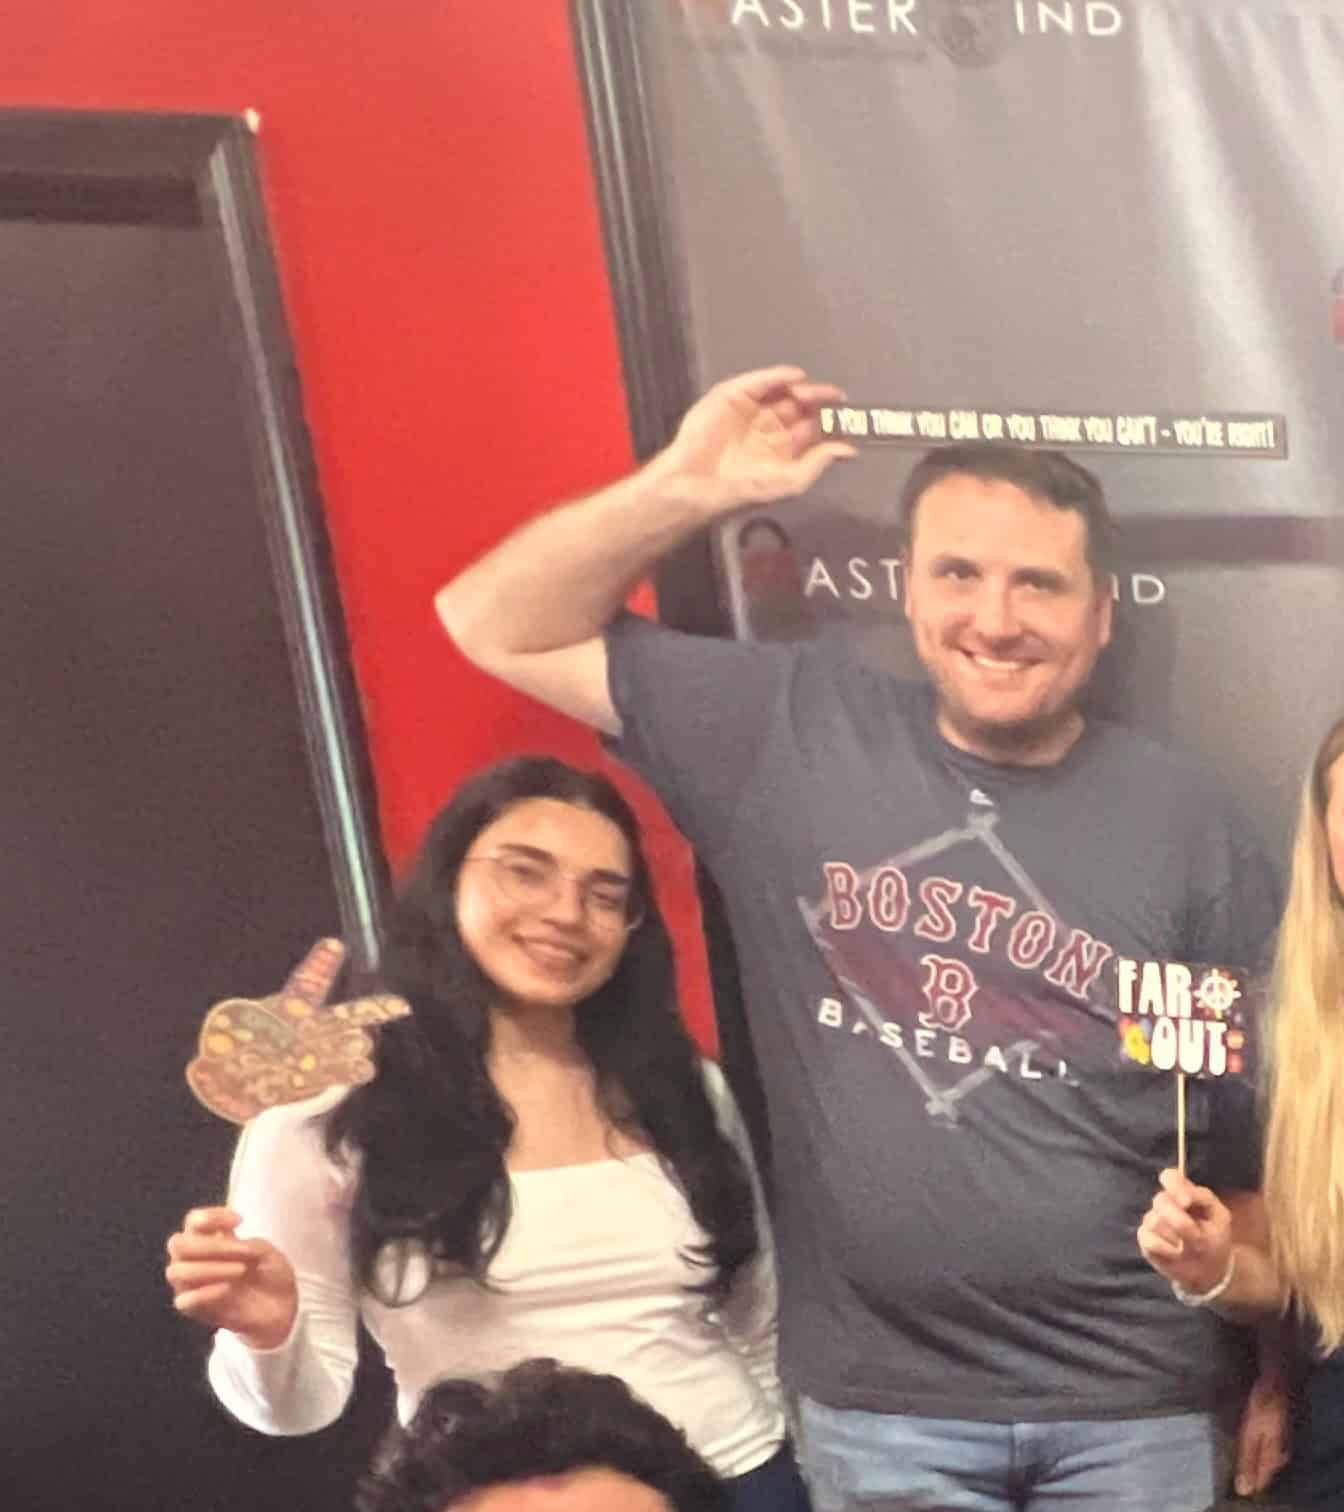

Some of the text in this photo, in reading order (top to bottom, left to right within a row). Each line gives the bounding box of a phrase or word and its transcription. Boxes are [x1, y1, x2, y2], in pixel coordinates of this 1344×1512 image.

[823, 861, 1115, 999] BOSTON
[918, 953, 979, 1032] B
[1117, 958, 1195, 1018] FAR
[1150, 1016, 1228, 1076] OUT
